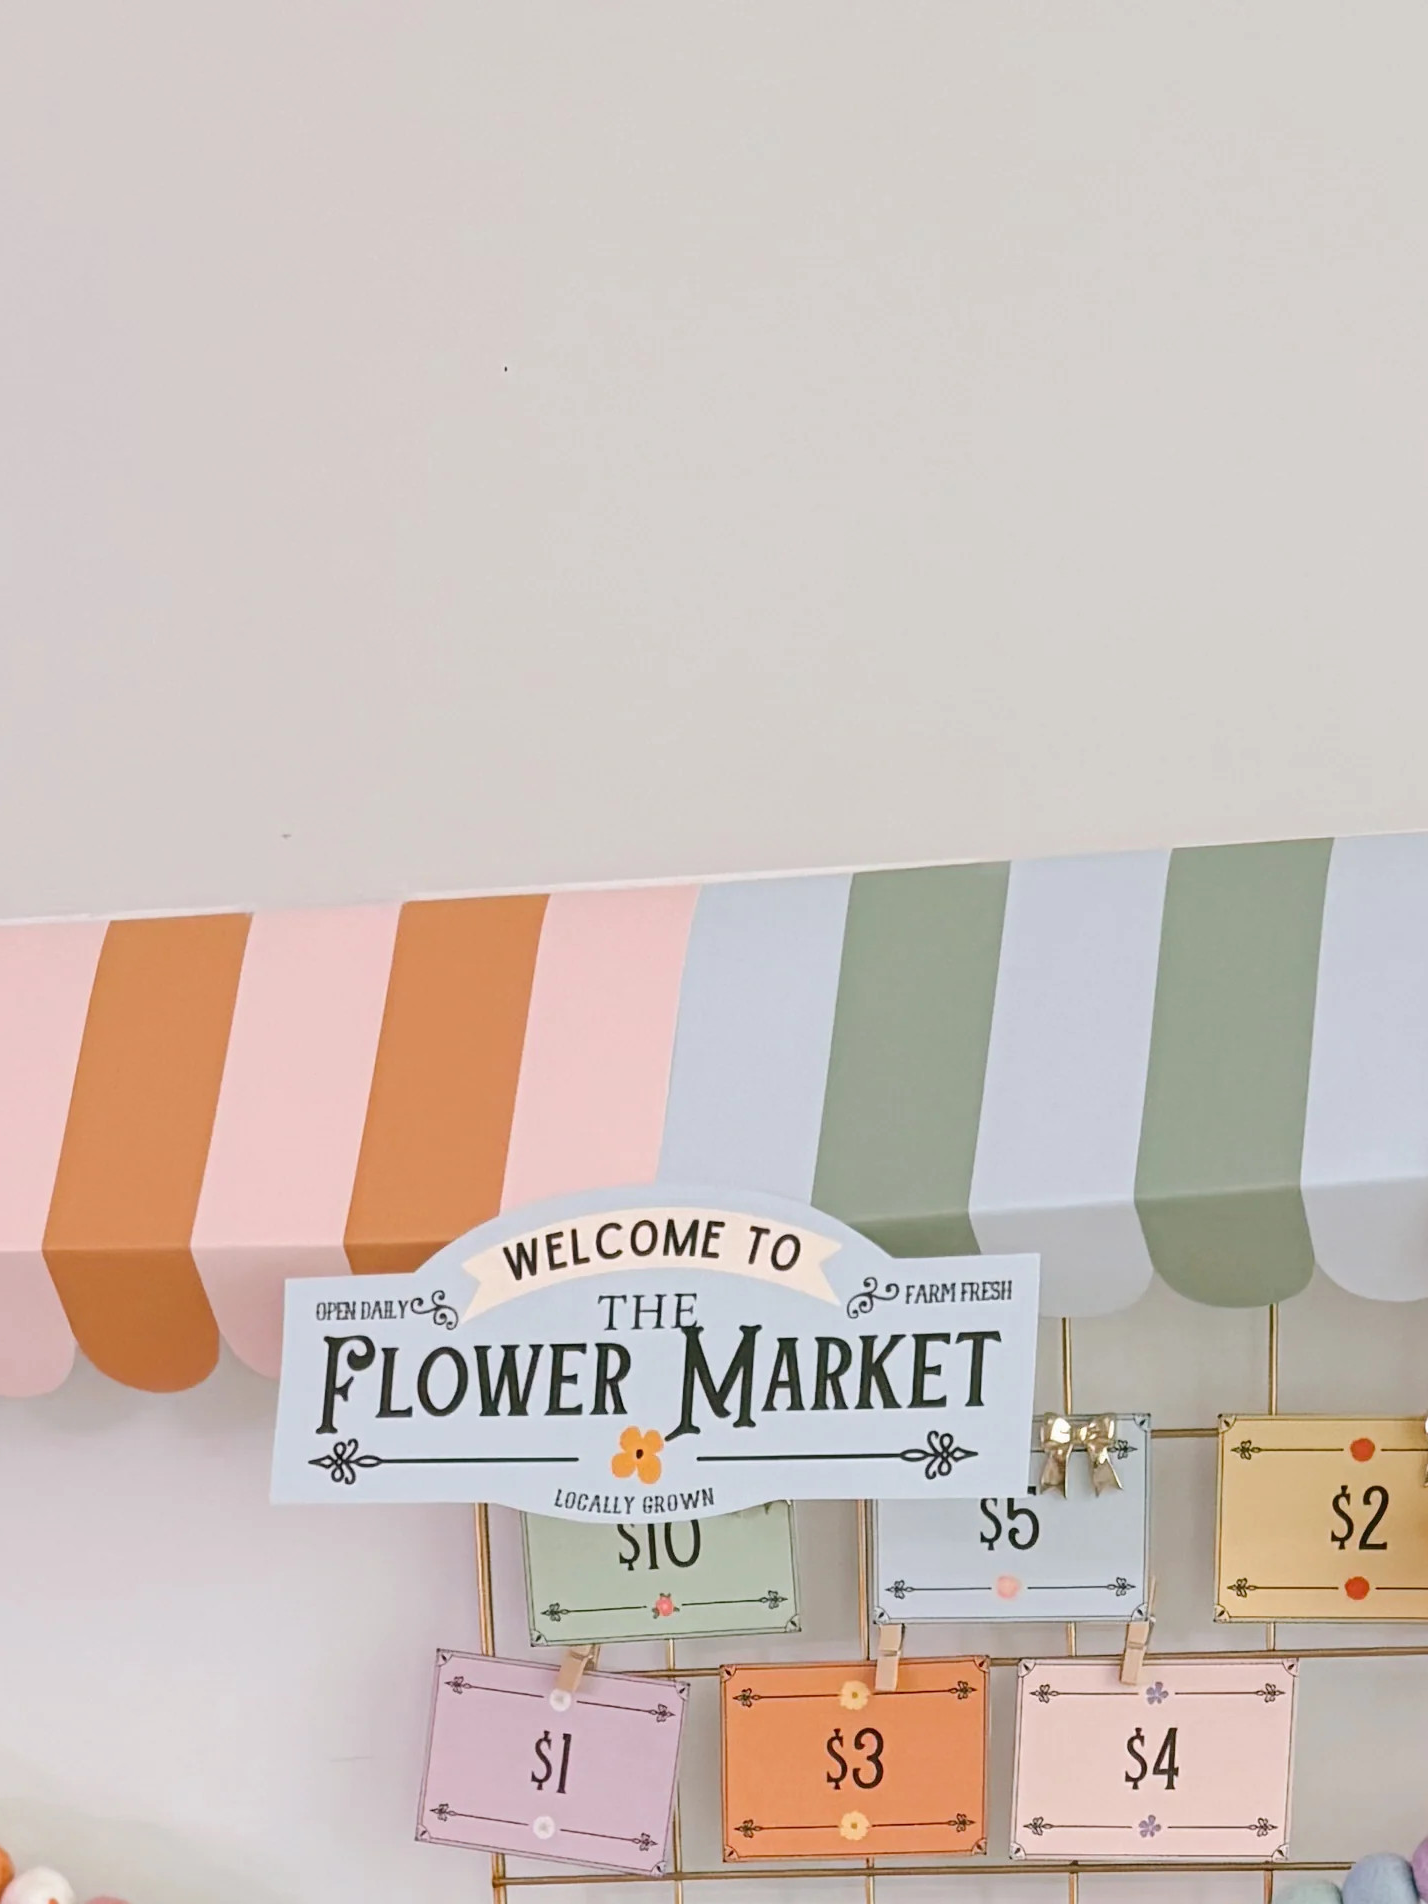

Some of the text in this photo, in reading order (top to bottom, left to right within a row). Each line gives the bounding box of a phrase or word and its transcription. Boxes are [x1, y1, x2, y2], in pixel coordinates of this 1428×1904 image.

[503, 1219, 802, 1282] WELCOME TO
[315, 1298, 408, 1322] OPEN DAILY
[598, 1293, 699, 1331] THE
[905, 1279, 1013, 1305] FARM FRESH
[315, 1324, 1003, 1441] FLOWER MARKET
[554, 1488, 715, 1515] LOCALLY GROWN
[978, 1497, 1040, 1551] $5
[1329, 1485, 1390, 1551] $2
[618, 1523, 702, 1571] $10
[530, 1730, 573, 1795] $1
[826, 1728, 885, 1791] $3
[1124, 1726, 1180, 1791] $4
